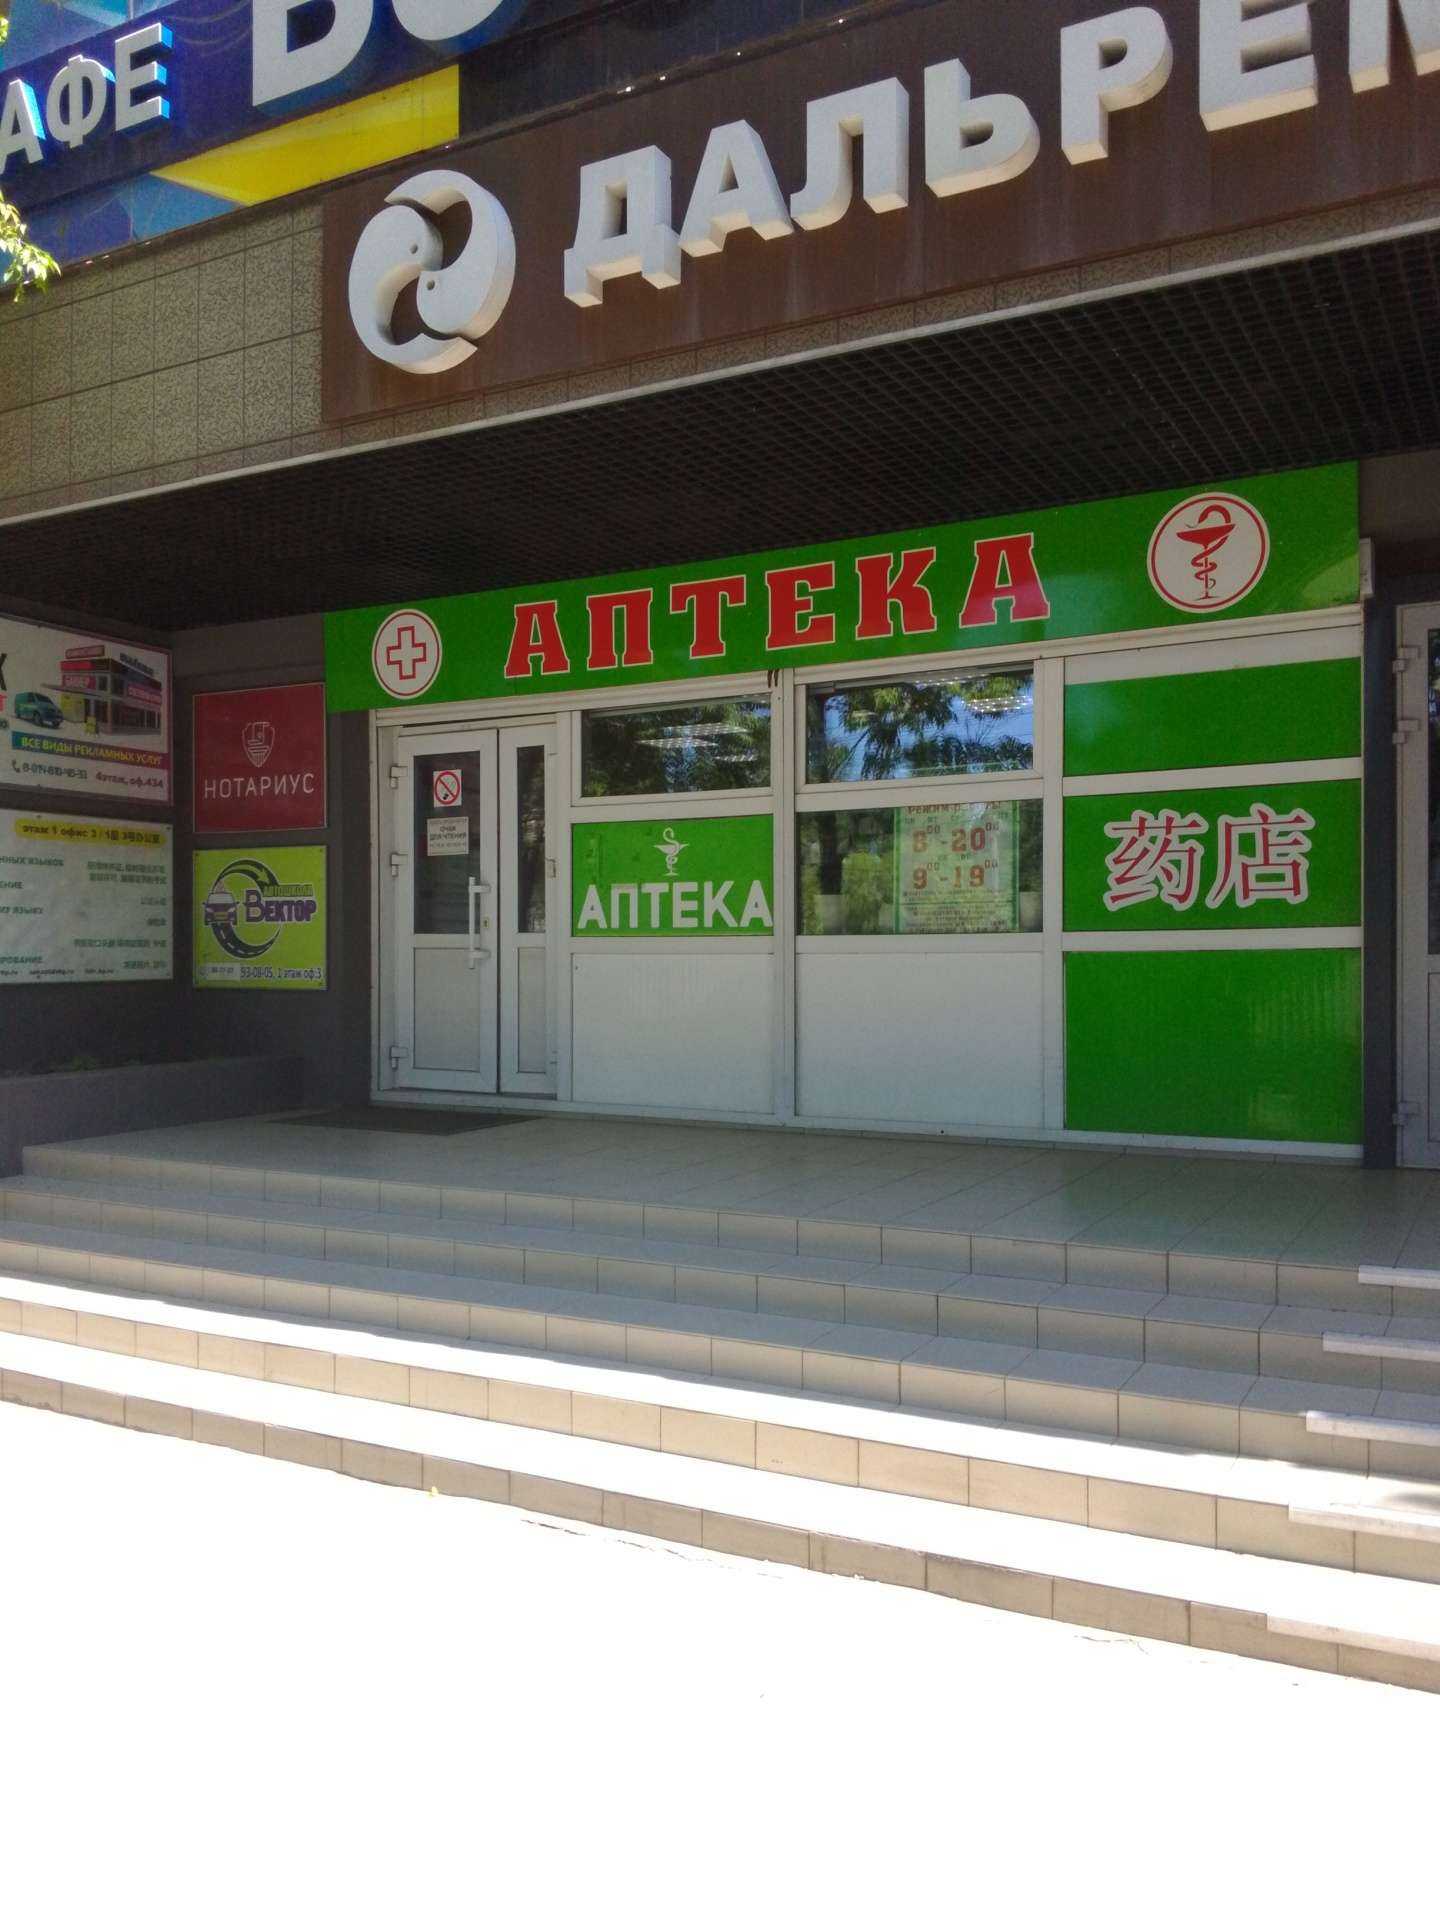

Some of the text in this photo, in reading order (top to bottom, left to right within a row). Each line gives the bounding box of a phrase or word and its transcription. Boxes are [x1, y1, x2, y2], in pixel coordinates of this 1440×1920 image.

[503, 532, 1051, 680] АПТЕКА
[21, 736, 41, 749] ВСЕ
[42, 738, 73, 754] ВИДЫ
[74, 742, 135, 763] РЕКЛАМНЫХ
[204, 772, 316, 799] НОТАРИУС
[59, 828, 89, 839] офис
[1104, 803, 1315, 912] 药店
[578, 880, 773, 929] АПТЕКА
